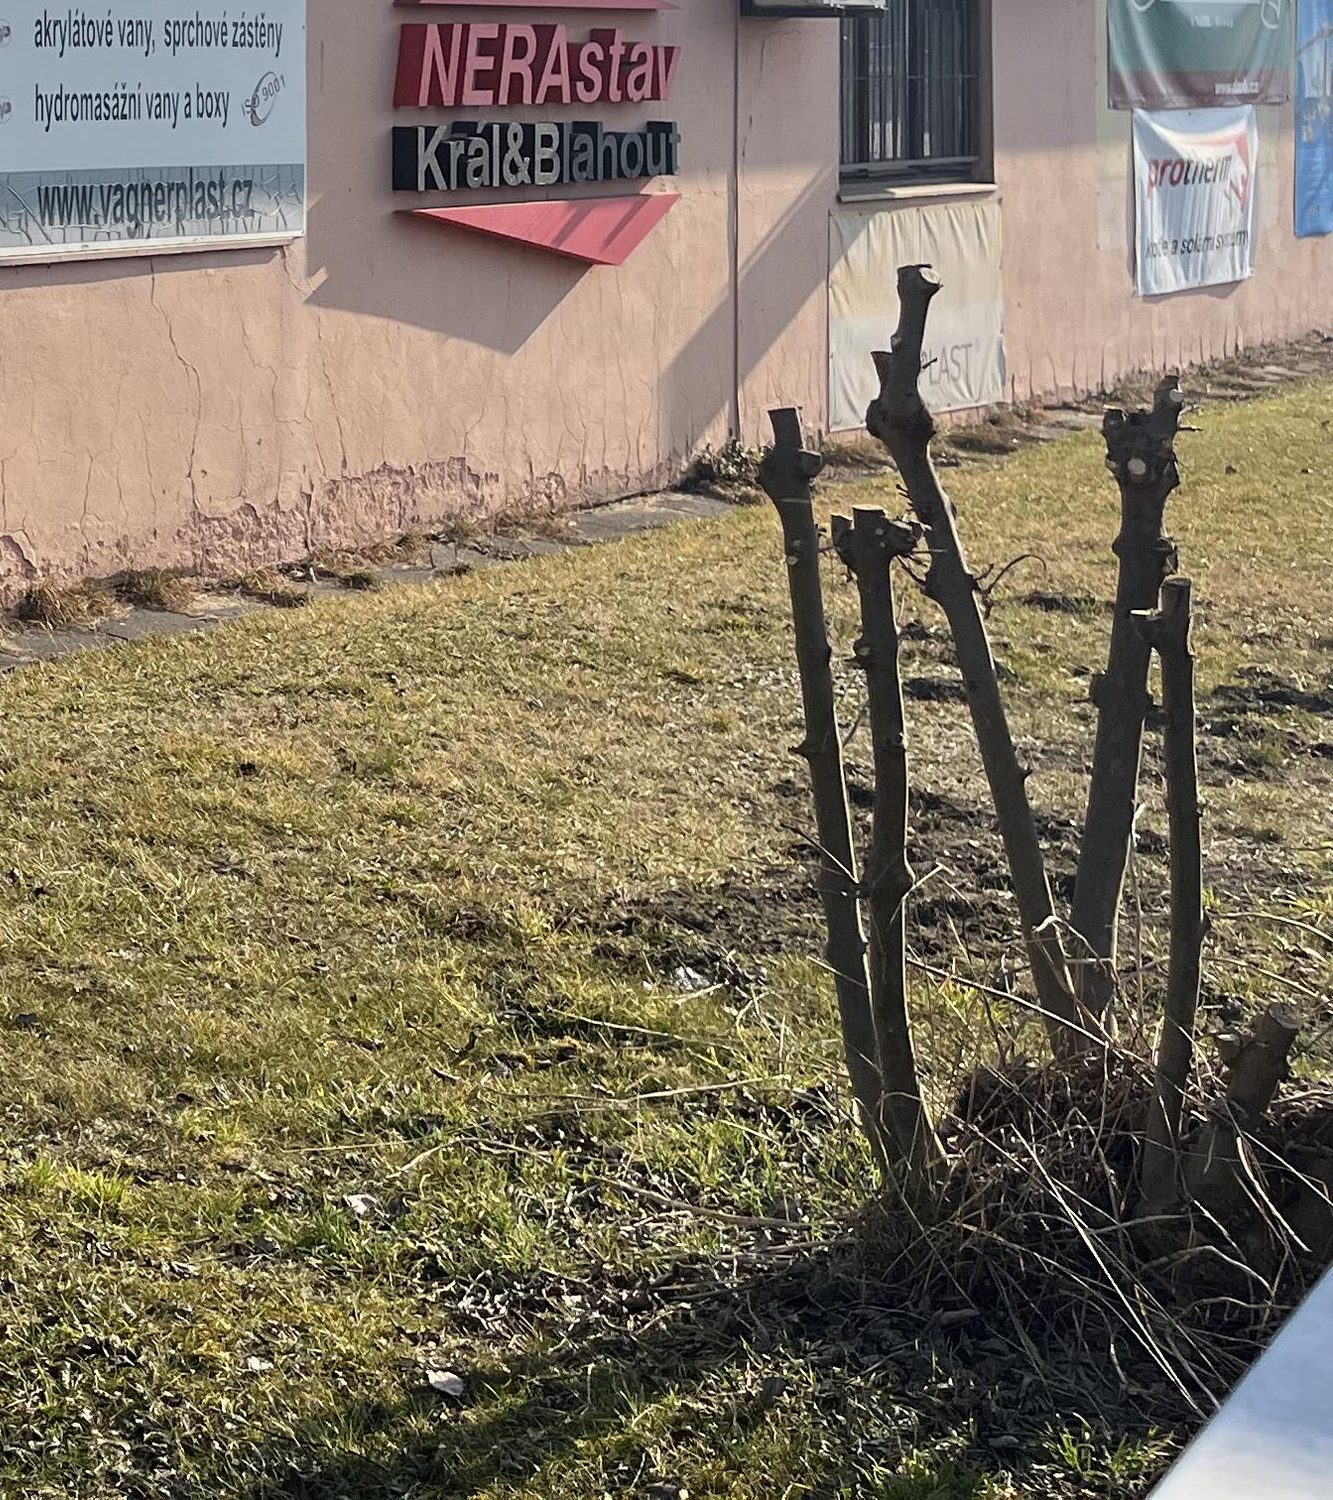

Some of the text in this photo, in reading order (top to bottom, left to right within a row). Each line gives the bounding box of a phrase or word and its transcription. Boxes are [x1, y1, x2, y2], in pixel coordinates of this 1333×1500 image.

[34, 9, 283, 58] akrylátové vany, sprchové zástěny
[397, 24, 682, 108] NERAstav
[34, 83, 230, 132] hydromasážní vany a boxy
[37, 168, 254, 238] www.vagnerplast.cz
